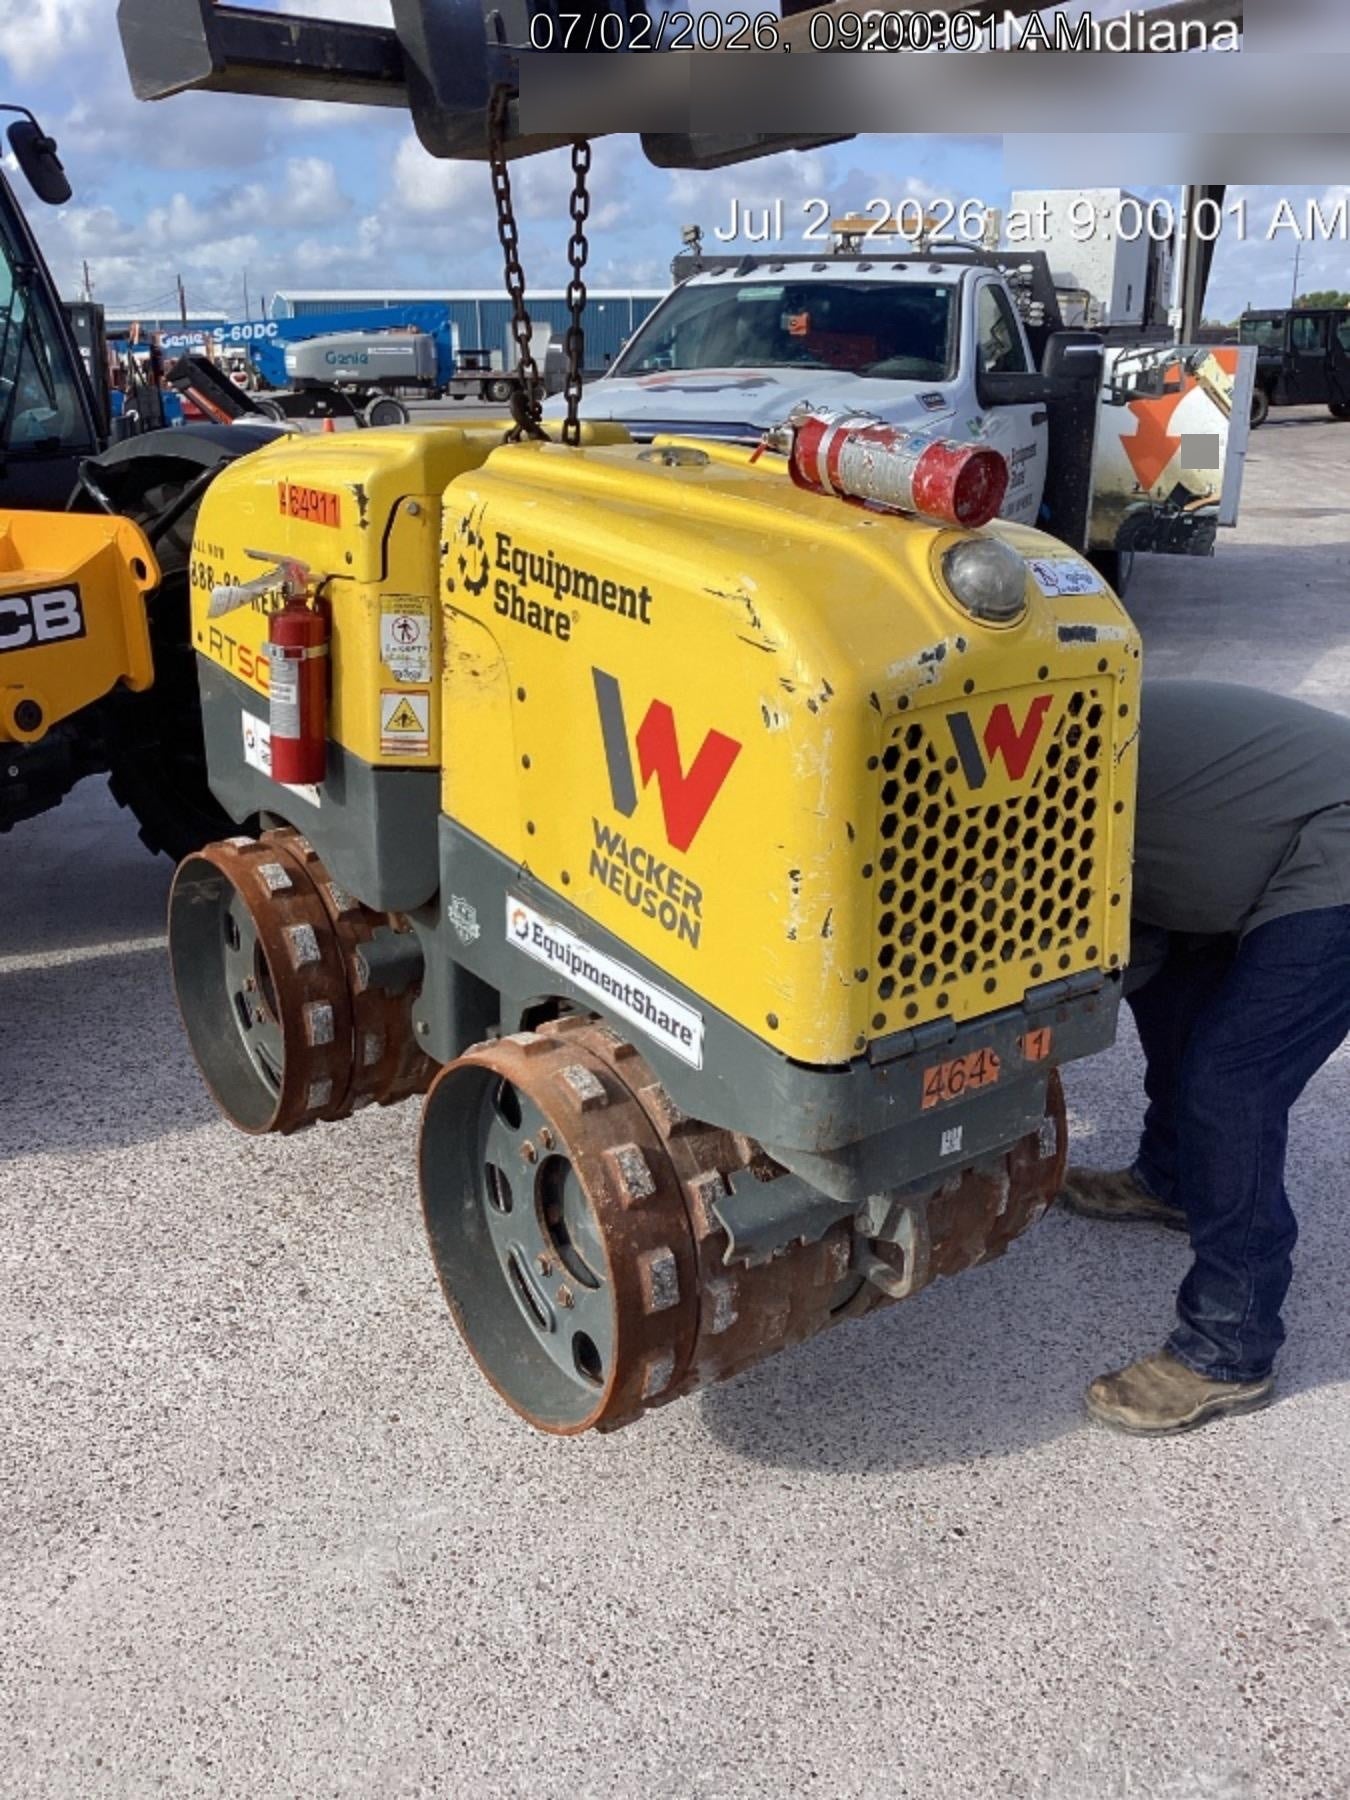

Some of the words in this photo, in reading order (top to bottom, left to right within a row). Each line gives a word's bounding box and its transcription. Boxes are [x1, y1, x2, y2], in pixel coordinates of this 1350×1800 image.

[213, 322, 278, 341] S-60DC
[325, 351, 369, 365] Genie
[495, 531, 653, 625] Equipment
[589, 848, 702, 950] NEUSON
[592, 816, 703, 919] WACKER
[532, 922, 694, 1047] EquipmentShare
